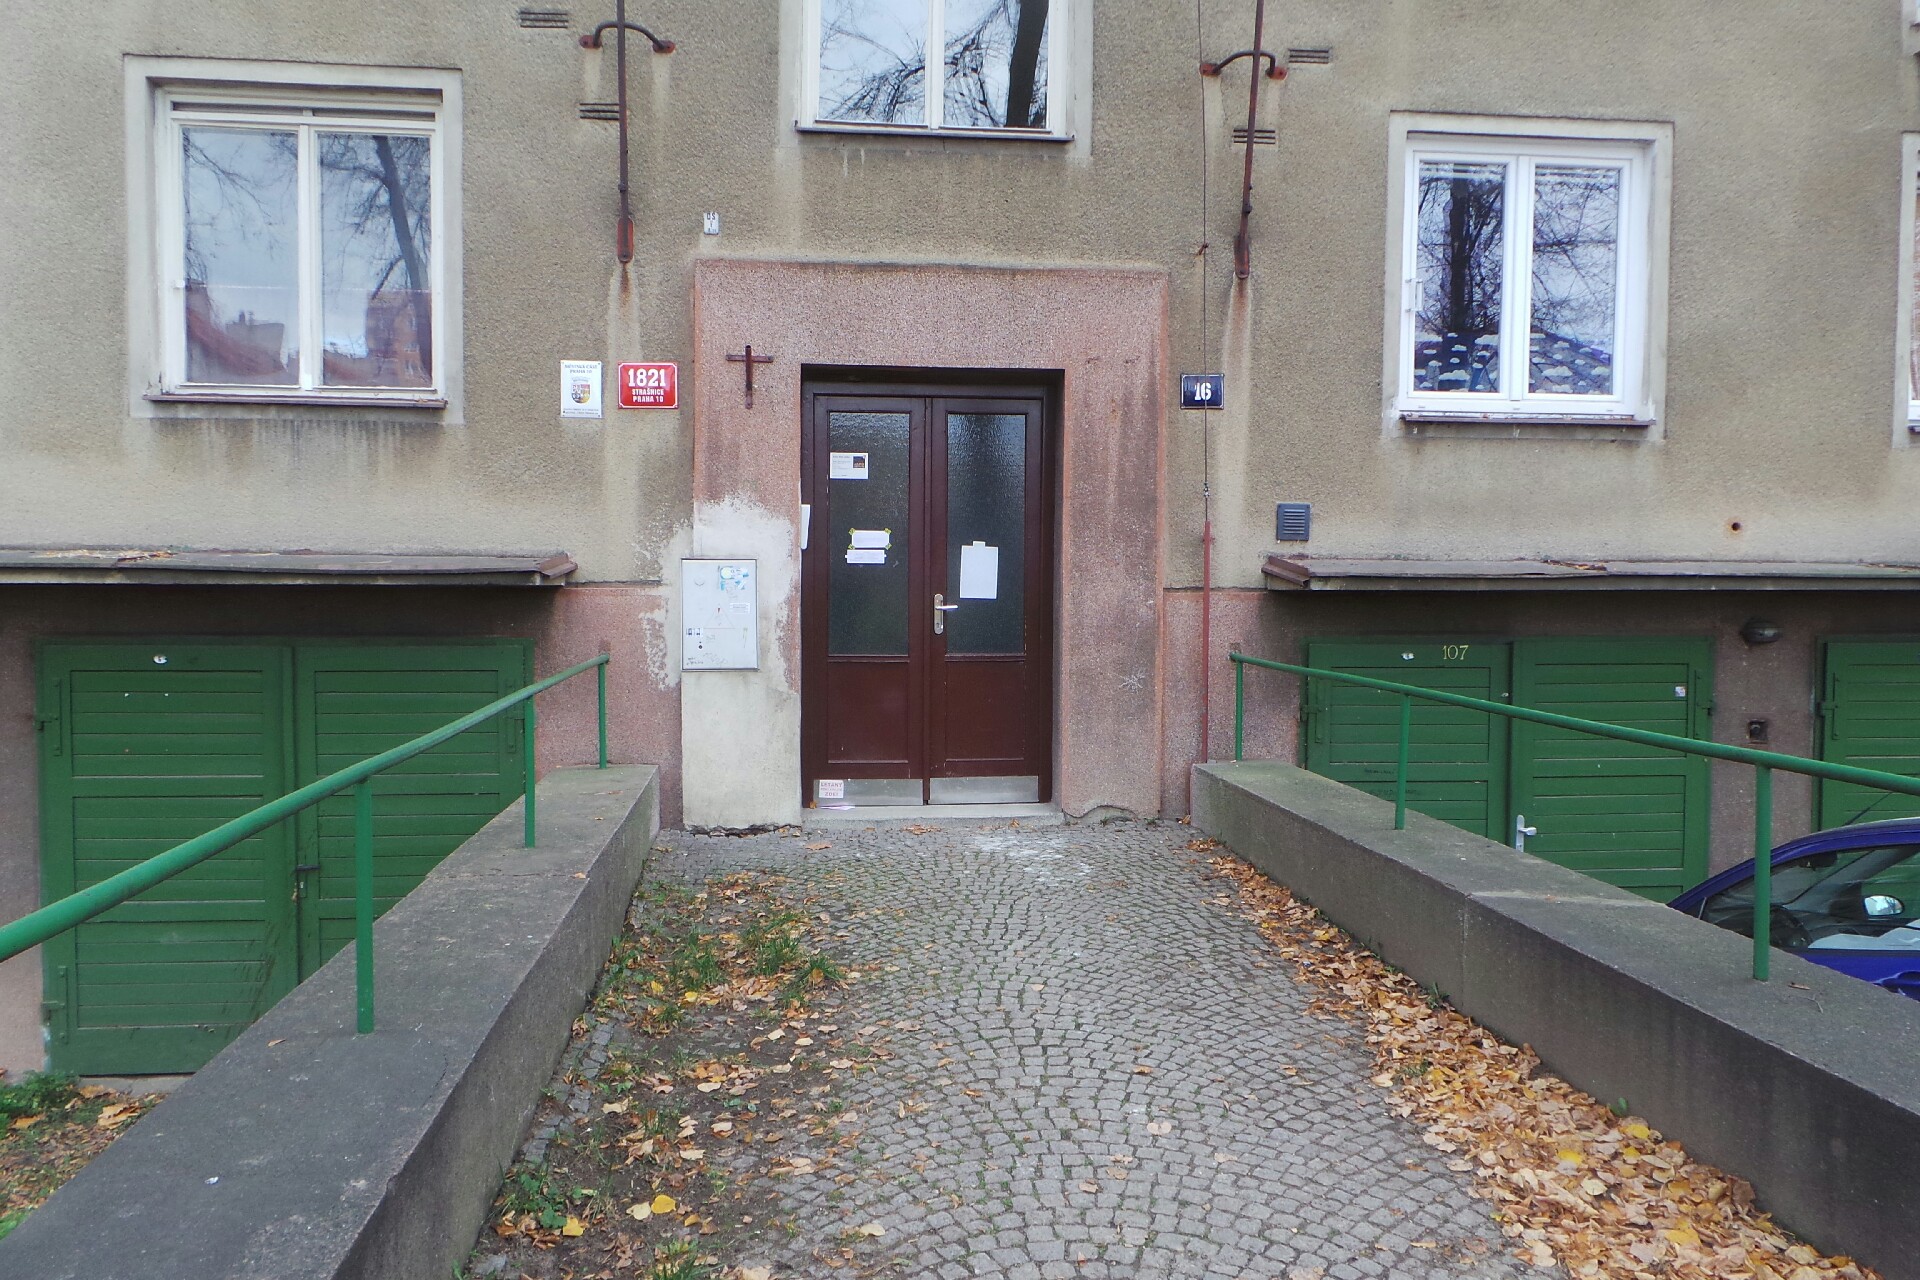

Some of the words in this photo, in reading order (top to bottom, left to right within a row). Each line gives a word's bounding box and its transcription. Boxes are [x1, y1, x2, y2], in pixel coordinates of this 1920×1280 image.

[628, 368, 666, 387] 1821
[632, 388, 664, 396] STRAŠNICE
[1194, 382, 1212, 401] 16
[1442, 644, 1469, 661] 107
